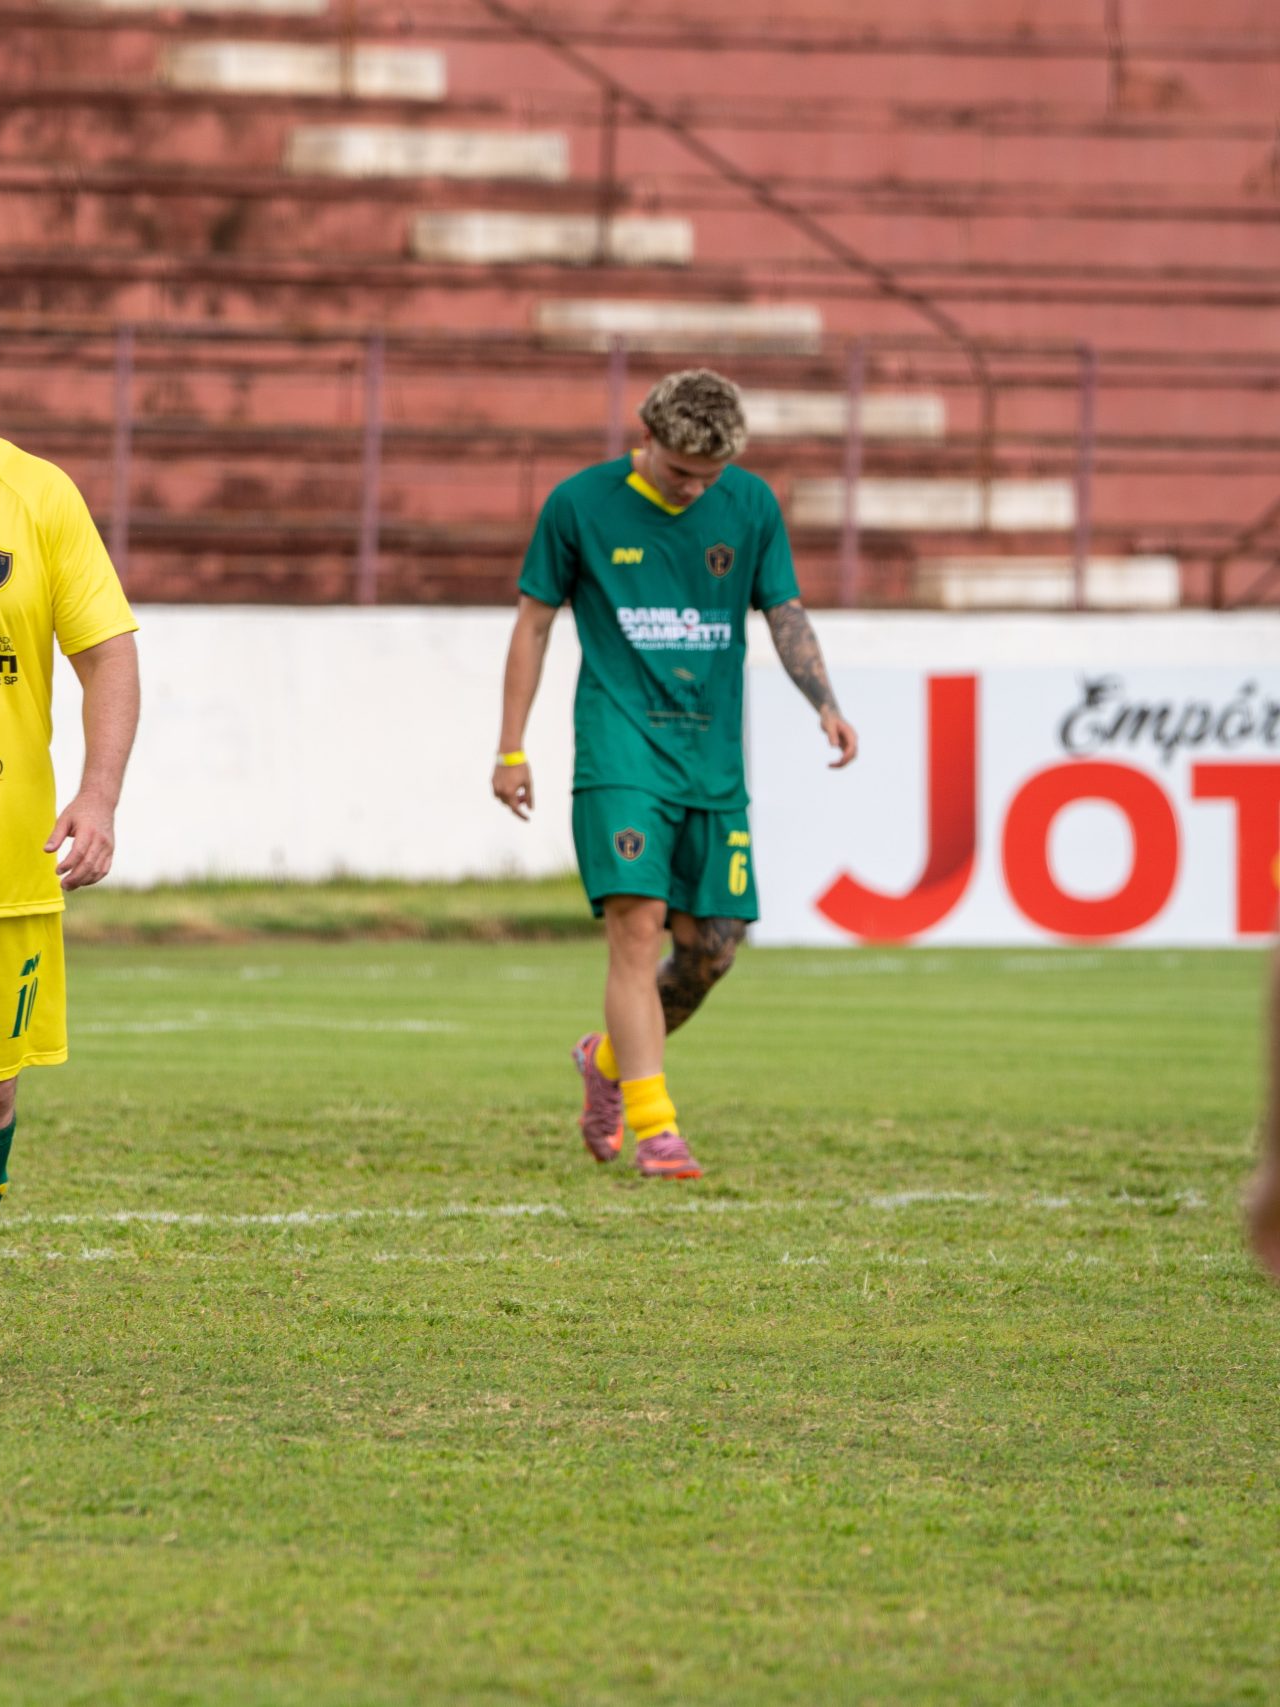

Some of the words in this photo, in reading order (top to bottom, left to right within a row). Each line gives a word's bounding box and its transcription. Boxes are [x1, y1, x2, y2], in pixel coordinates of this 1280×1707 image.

[617, 607, 701, 625] DANILO
[4, 676, 18, 686] SP
[728, 851, 748, 896] 6
[8, 977, 38, 1039] 10
